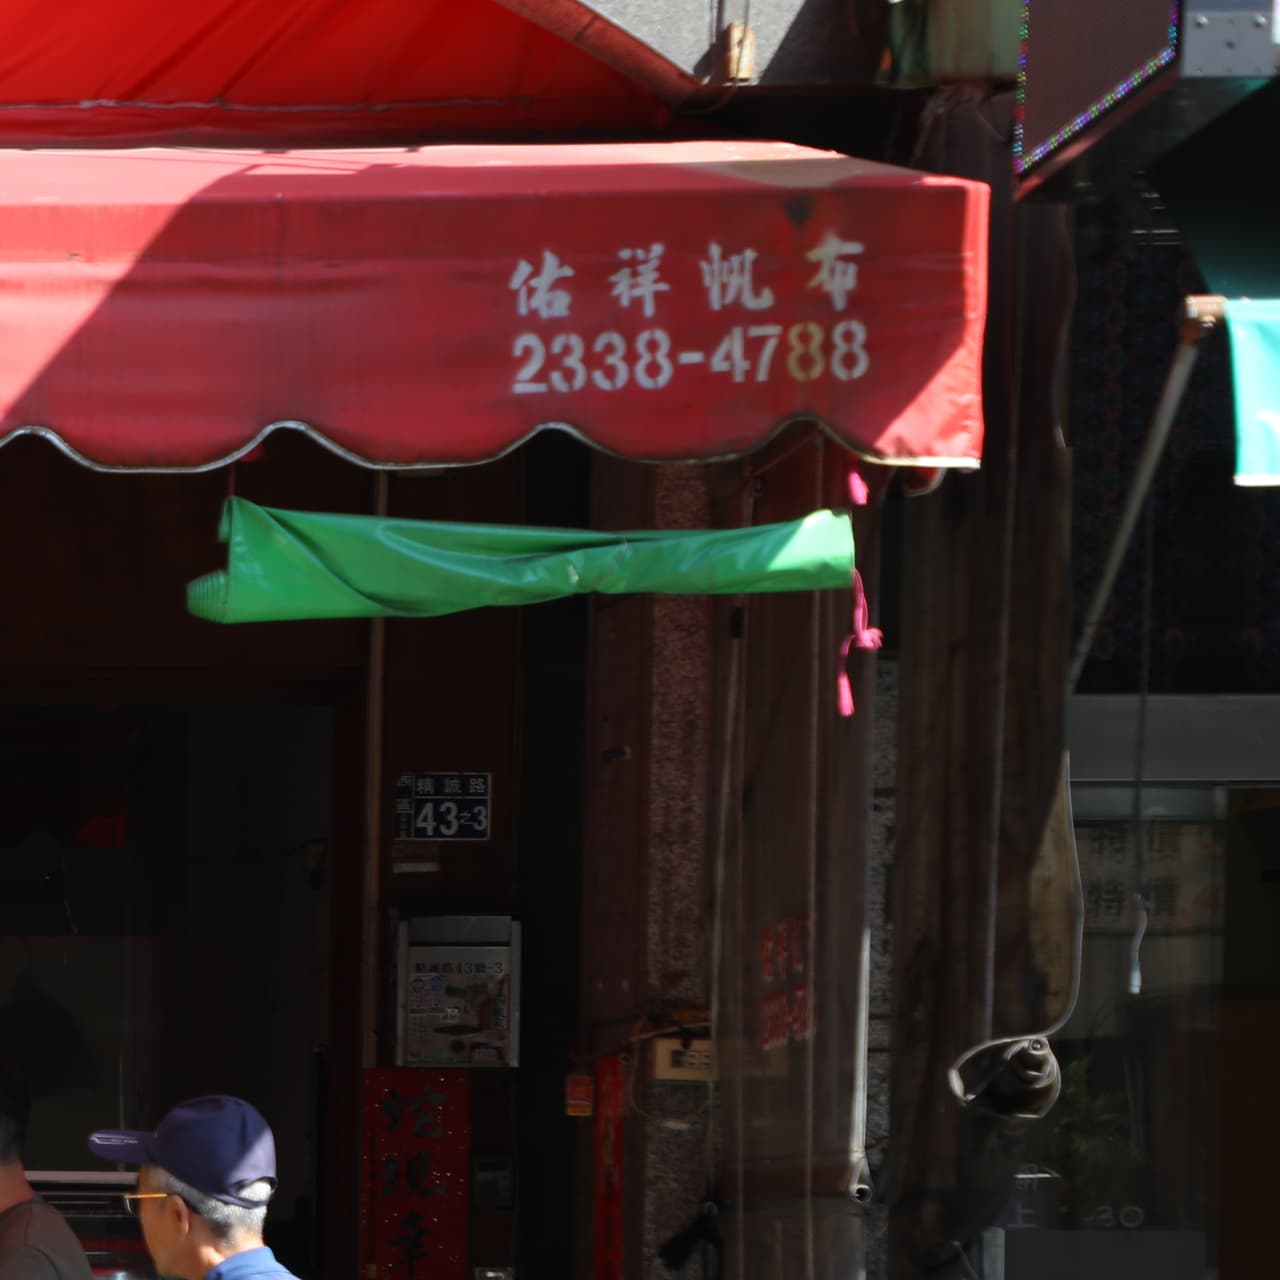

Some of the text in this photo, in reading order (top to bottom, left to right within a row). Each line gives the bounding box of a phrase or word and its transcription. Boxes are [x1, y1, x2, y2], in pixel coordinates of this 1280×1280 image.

[508, 230, 866, 319] 佑祥帆布
[511, 318, 871, 396] 2338-4788
